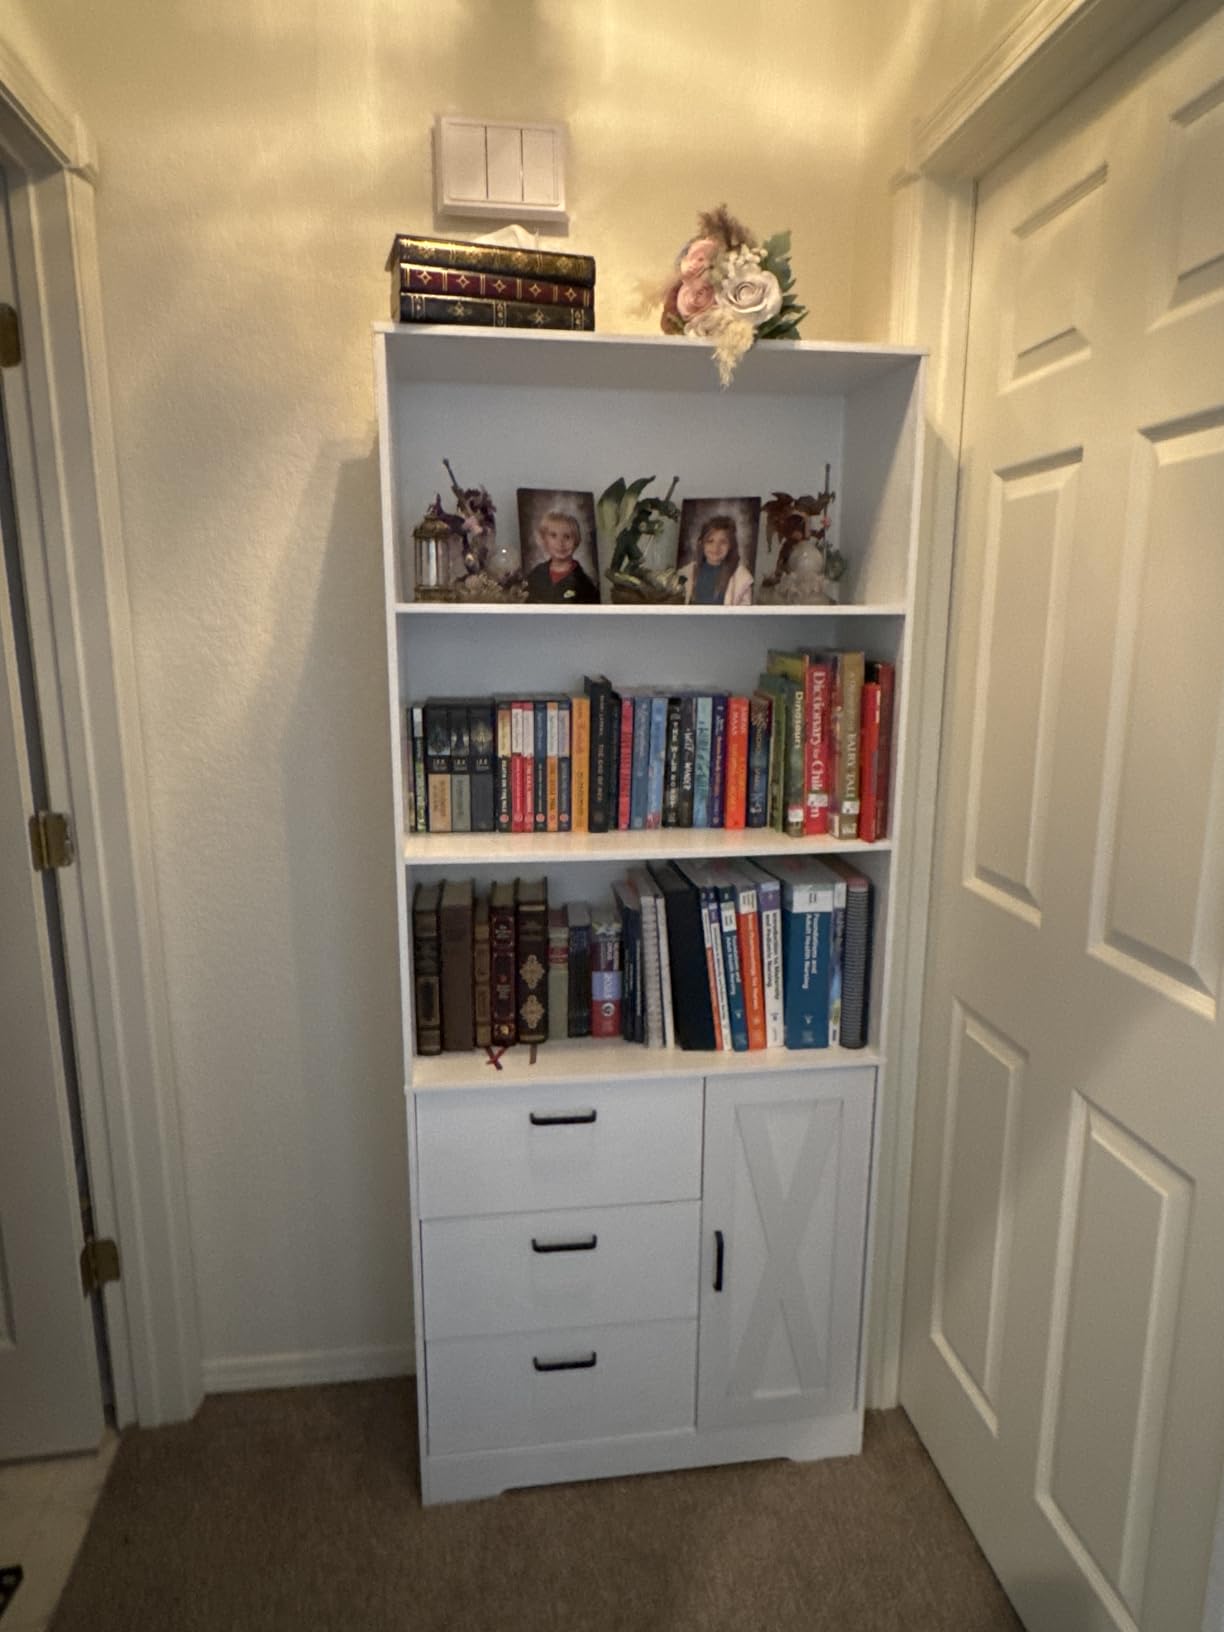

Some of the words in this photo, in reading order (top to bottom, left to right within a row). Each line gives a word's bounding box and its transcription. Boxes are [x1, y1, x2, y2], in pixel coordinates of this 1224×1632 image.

[794, 690, 804, 749] Dinosaurs
[810, 671, 826, 746] Dictionary
[847, 733, 857, 767] FAIRY
[810, 760, 825, 818] Chiln
[804, 935, 812, 959] Health
[811, 912, 820, 958] Foundations
[802, 960, 811, 989] Nursing
